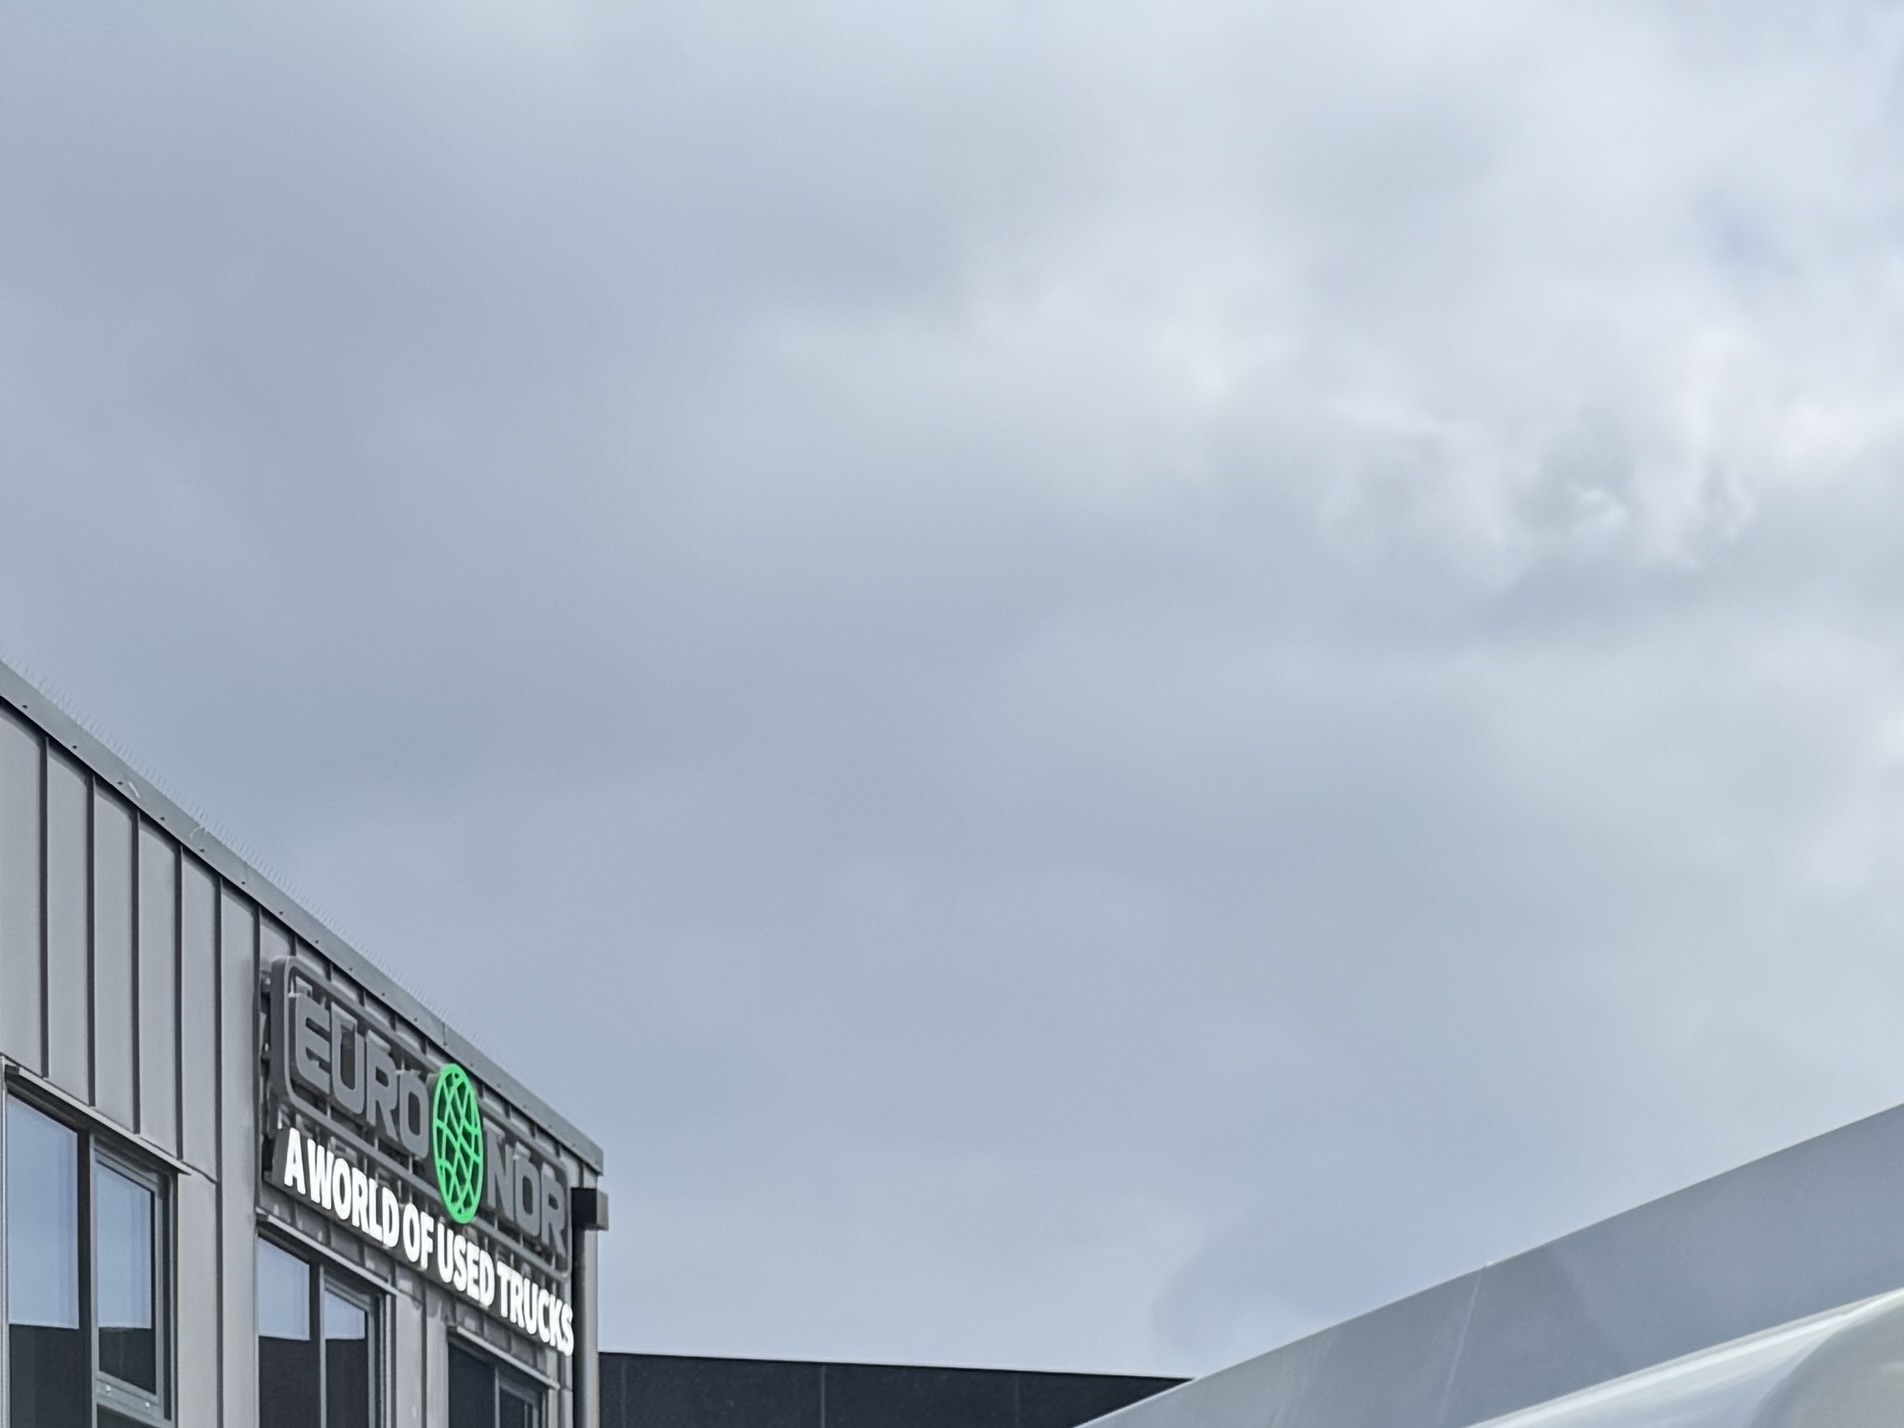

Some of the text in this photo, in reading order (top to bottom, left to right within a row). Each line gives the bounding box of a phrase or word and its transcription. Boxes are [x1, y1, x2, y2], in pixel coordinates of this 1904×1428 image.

[283, 1127, 575, 1357] A WORLD OF USED TRUCKS
[293, 990, 567, 1257] EURO NOR
